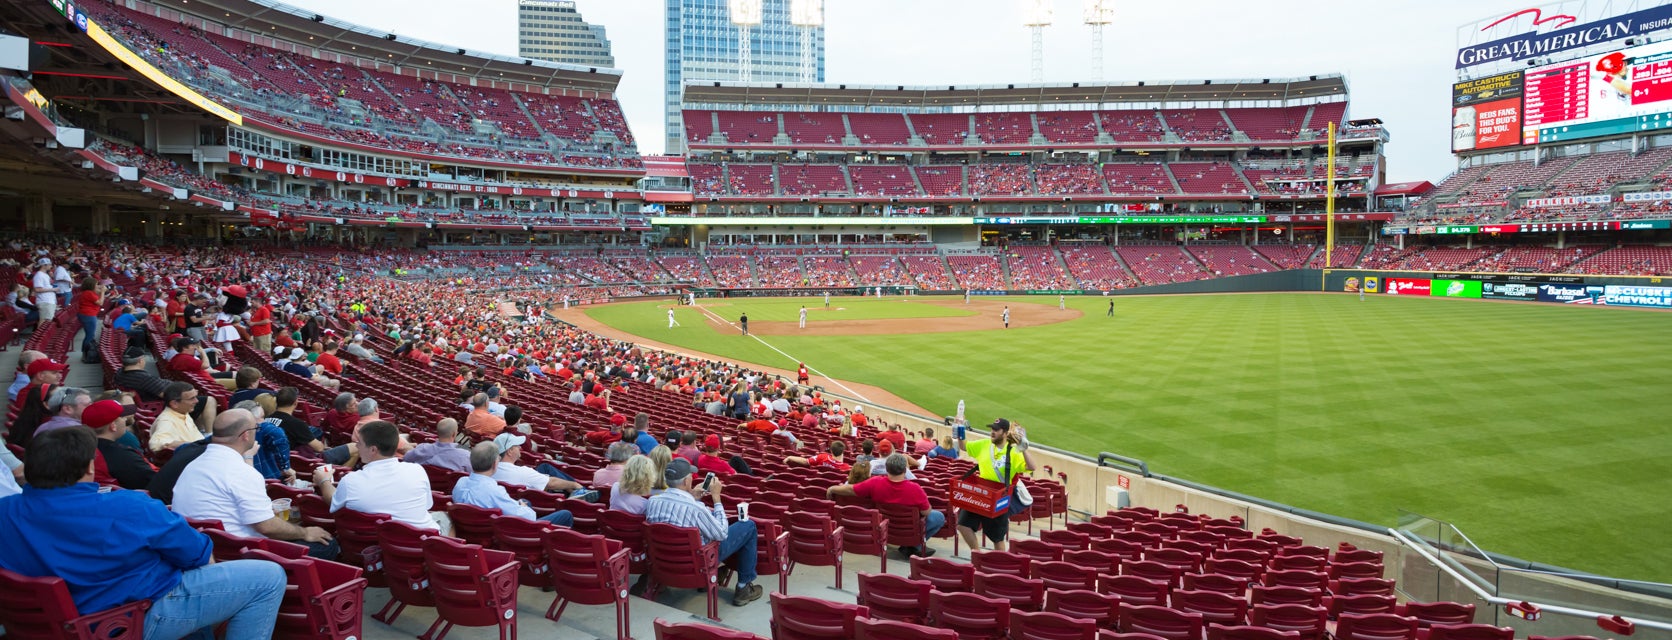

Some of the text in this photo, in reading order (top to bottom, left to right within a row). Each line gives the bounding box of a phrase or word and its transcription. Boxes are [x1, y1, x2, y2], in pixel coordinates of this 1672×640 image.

[1639, 17, 1672, 32] INSURA
[1455, 82, 1473, 90] MIKE
[1475, 72, 1520, 86] CASTRUCCI
[1462, 80, 1511, 94] AUTOMOTIVE
[1479, 110, 1497, 119] REDS
[1479, 119, 1495, 127] THIS
[1479, 126, 1492, 135] FOR
[1547, 285, 1586, 297] Barbasol
[1606, 295, 1671, 306] CHEVROLE
[953, 490, 991, 509] Budweiser
